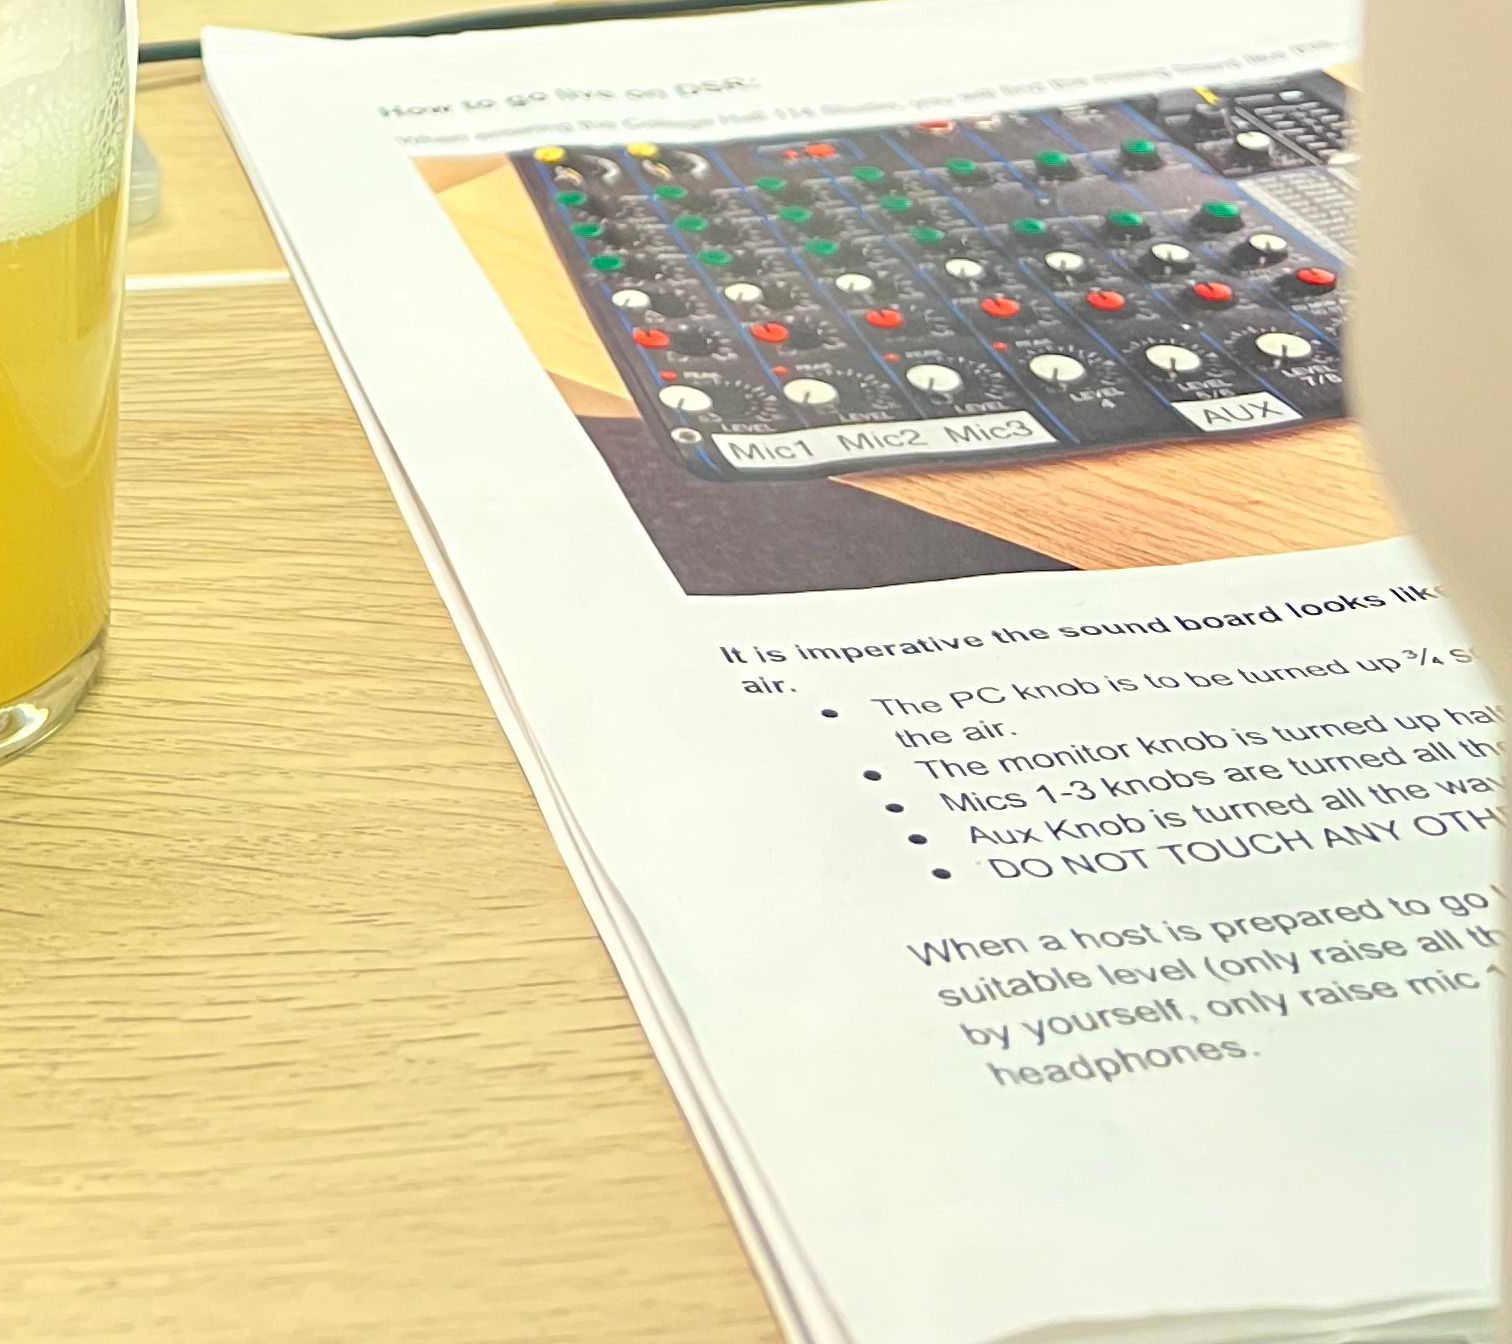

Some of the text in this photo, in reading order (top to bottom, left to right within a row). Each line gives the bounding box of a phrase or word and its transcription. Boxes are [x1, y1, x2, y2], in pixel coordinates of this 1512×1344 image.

[727, 419, 1035, 463] Mic1 Mic2 Mic3
[1203, 400, 1284, 425] AUX
[720, 645, 748, 663] It
[753, 645, 787, 663] is
[794, 634, 985, 663] imperative
[991, 627, 1050, 644] the
[1057, 616, 1171, 638] sound
[1174, 605, 1284, 632] board
[1285, 593, 1387, 619] looks
[741, 676, 798, 694] air.
[869, 697, 943, 716] The
[949, 686, 1006, 709] PC
[1011, 676, 1101, 701] knob
[1108, 674, 1139, 693] is
[1144, 672, 1179, 690] to
[1185, 671, 1234, 689] be
[1238, 659, 1351, 685] turned
[1356, 657, 1401, 673] up
[894, 720, 1017, 748] the air.
[913, 758, 990, 779] The
[998, 742, 1131, 773] monitor
[1136, 730, 1228, 755] knob
[1231, 727, 1268, 746] is
[1271, 714, 1388, 743] turned
[1393, 714, 1441, 733] up
[939, 791, 1027, 812] Mics
[1036, 779, 1096, 804] 1-3
[1100, 768, 1216, 797] knobs
[1223, 762, 1283, 783] are
[1287, 746, 1407, 776] turned
[1413, 740, 1457, 762] all
[970, 824, 1043, 845] Aux
[1044, 813, 1146, 841] Knob
[1149, 808, 1187, 829] is
[1192, 793, 1314, 824] turned
[1321, 787, 1366, 811] all
[1367, 783, 1430, 805] the
[988, 807, 1507, 879] DO NOT TOUCH ANY OTH
[907, 936, 1029, 967] When
[1038, 934, 1067, 952] a
[1070, 922, 1162, 950] host
[1161, 919, 1203, 942] is
[1209, 898, 1385, 943] prepared
[1387, 897, 1431, 916] to
[1439, 892, 1489, 917] go
[938, 966, 1093, 1007] suitable
[1097, 957, 1197, 987] level
[1204, 948, 1300, 983] (only
[1309, 939, 1408, 966] raise
[1416, 928, 1465, 953] all
[960, 1023, 1011, 1050] by
[1021, 997, 1200, 1047] yourself,
[1206, 990, 1289, 1017] only
[1298, 980, 1399, 1008] raise
[1406, 968, 1481, 996] mic
[986, 1039, 1261, 1086] headphones.
